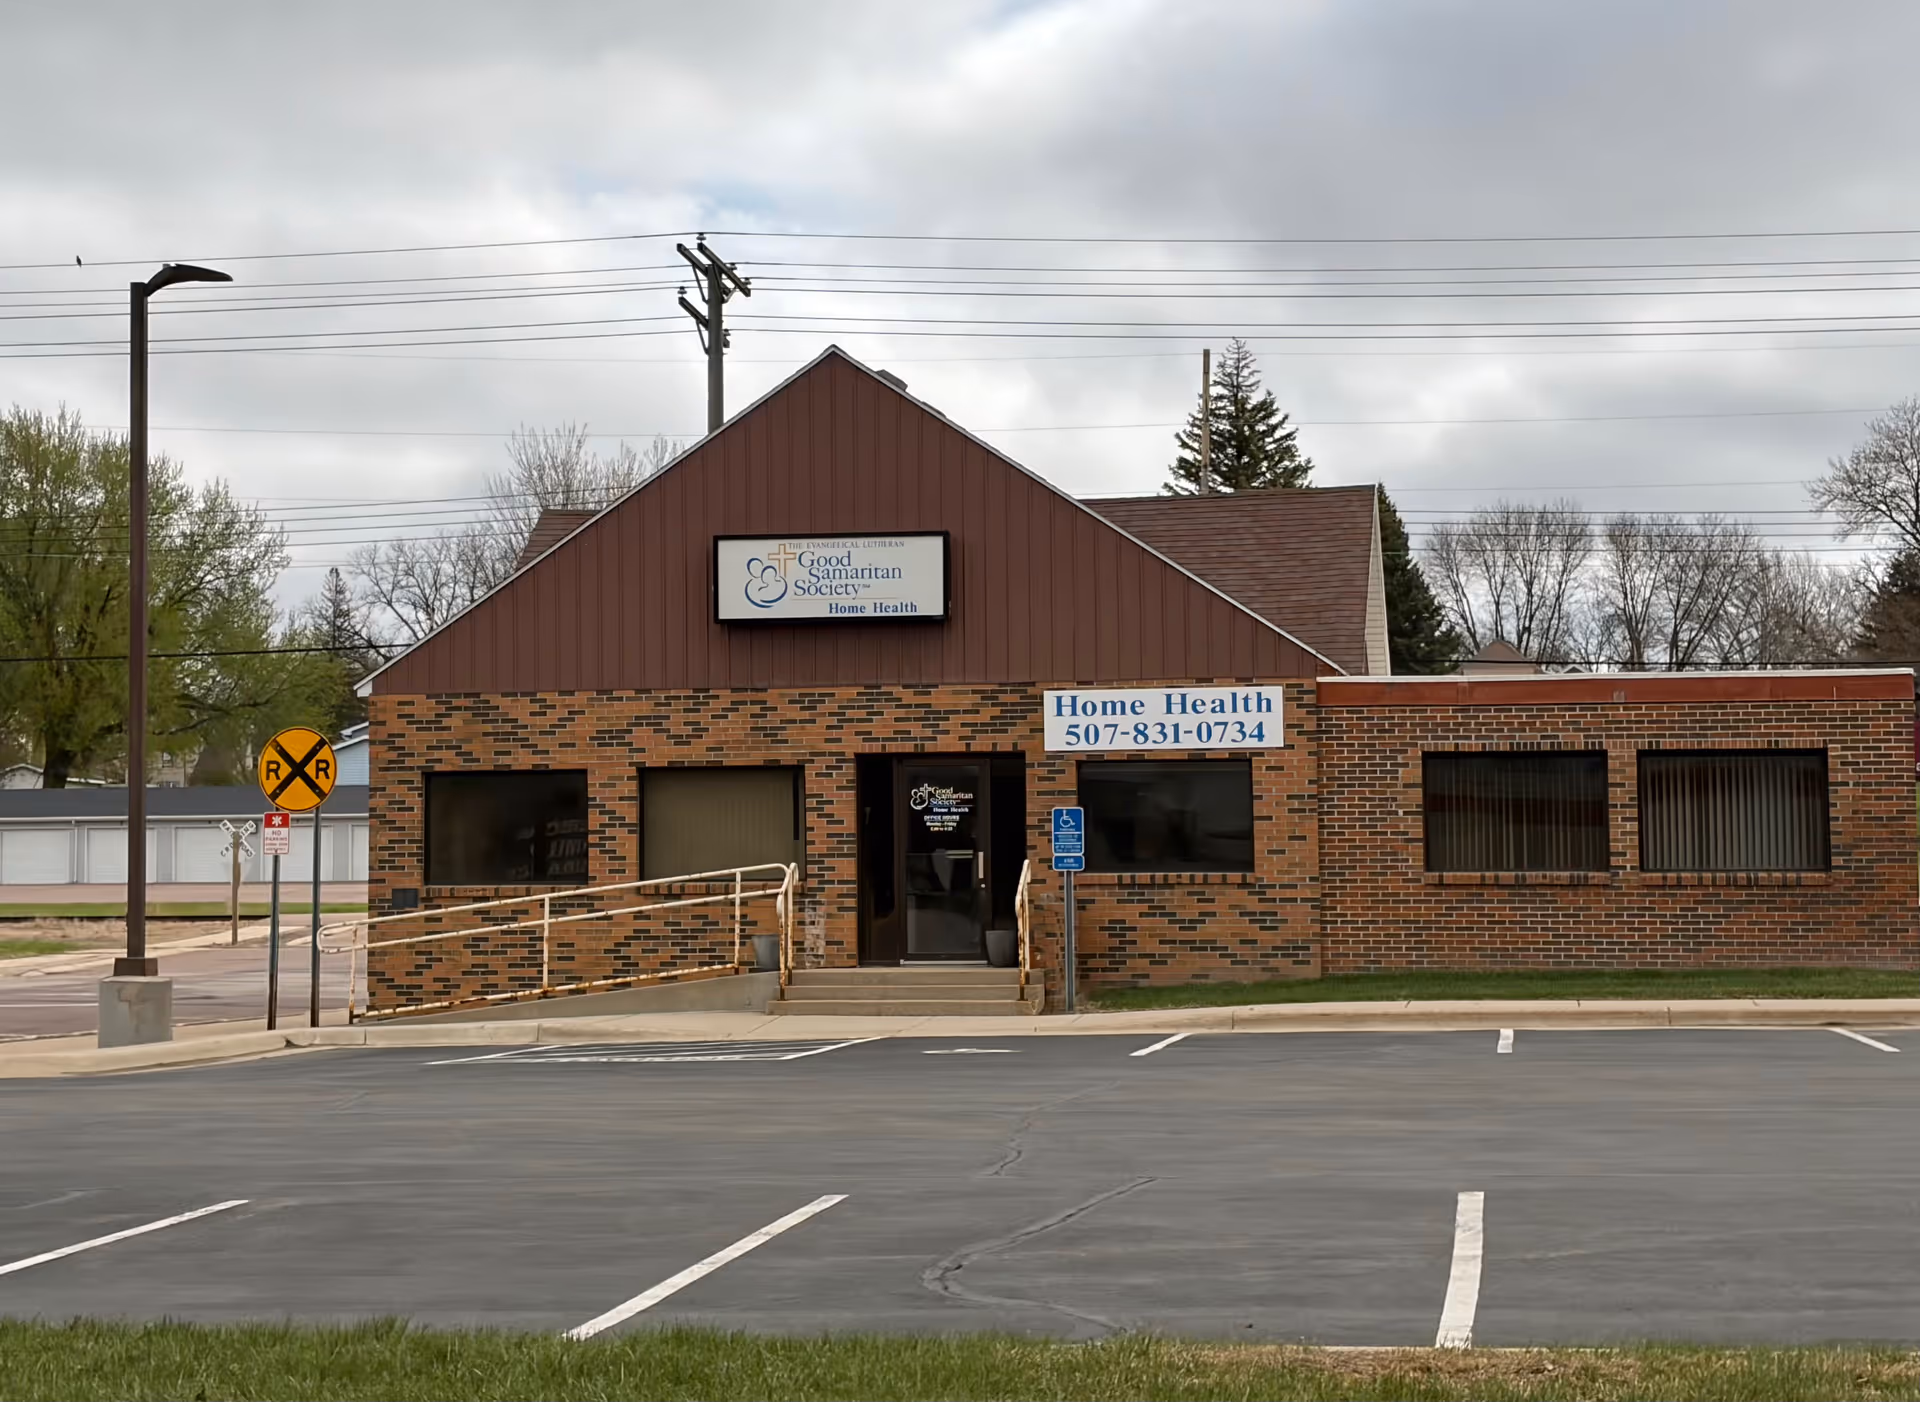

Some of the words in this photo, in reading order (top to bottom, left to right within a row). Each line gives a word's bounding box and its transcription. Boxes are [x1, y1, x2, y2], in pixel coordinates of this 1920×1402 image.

[798, 551, 851, 568] Good
[808, 563, 902, 585] Samaritan
[794, 579, 861, 600] Society
[828, 602, 866, 615] Home
[873, 601, 917, 613] Health
[1053, 695, 1145, 717] Home
[1163, 692, 1272, 715] Health
[1065, 721, 1265, 746] 507-831-0734
[931, 786, 953, 794] Good
[935, 792, 973, 800] Samaritan
[929, 798, 956, 806] Society
